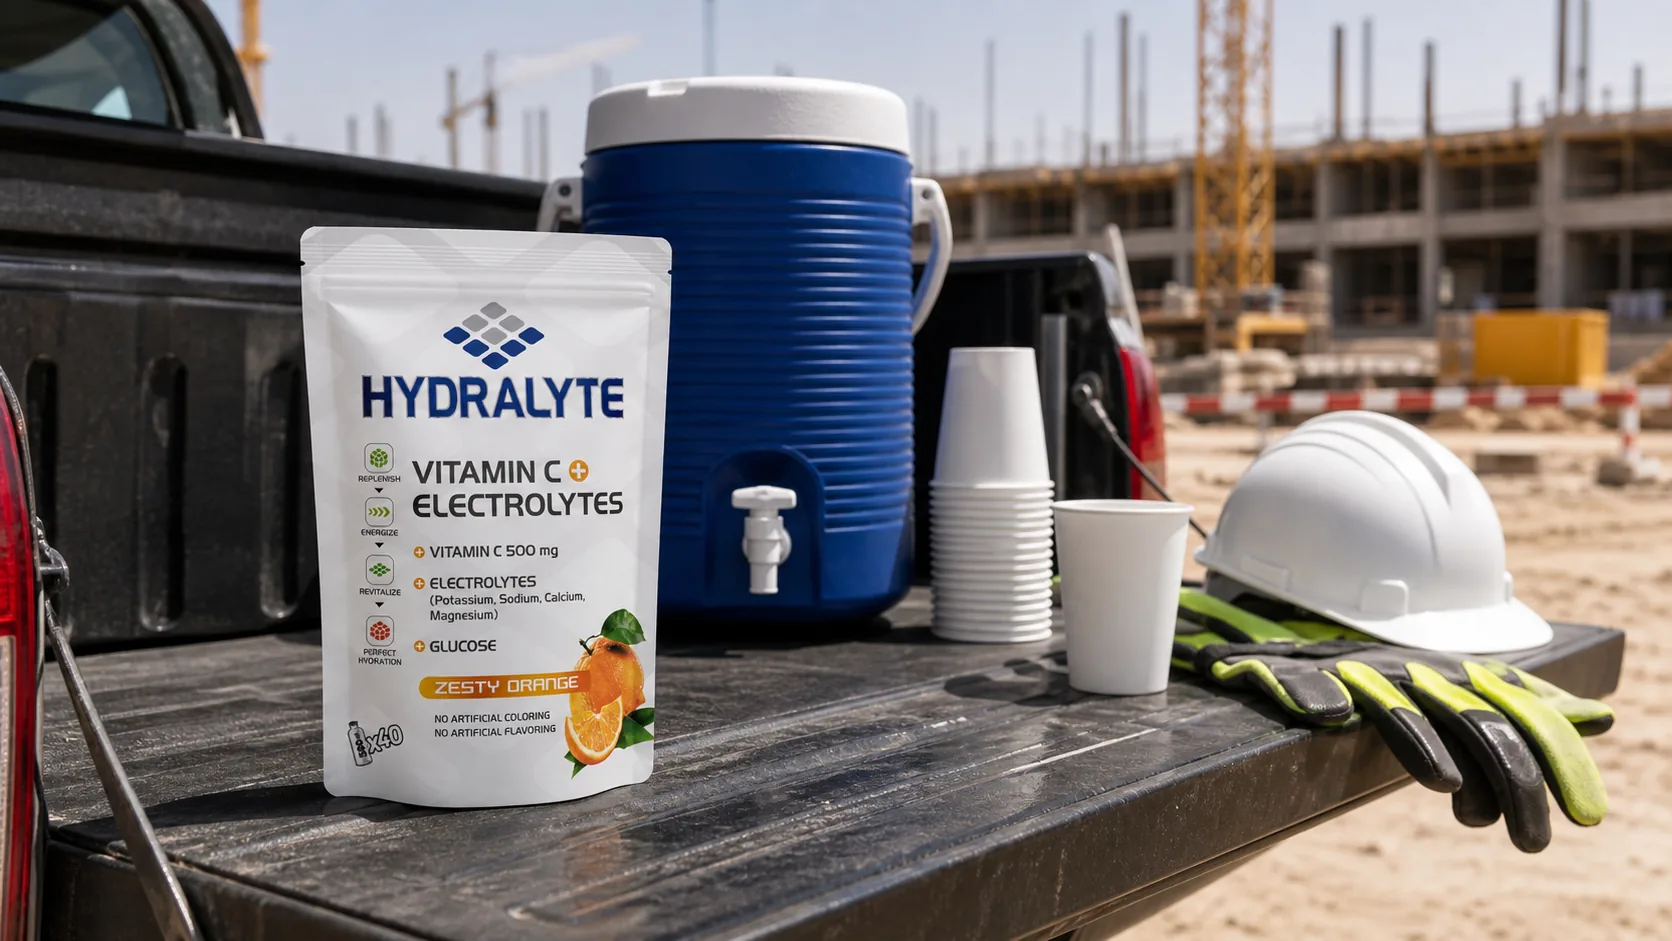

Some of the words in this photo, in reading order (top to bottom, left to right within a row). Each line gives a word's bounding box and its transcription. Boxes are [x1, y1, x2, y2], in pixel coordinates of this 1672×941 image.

[362, 375, 624, 418] HYDRALYTE
[412, 460, 535, 484] VITAMIN
[544, 460, 561, 483] C
[358, 475, 401, 483] REPLENISH
[412, 492, 623, 517] ELECTROLYTES
[361, 528, 399, 537] ENERGIZE
[430, 546, 489, 558] VITAMIN
[494, 545, 502, 557] C
[507, 545, 535, 557] 500
[540, 547, 559, 558] mg
[430, 576, 536, 589] ELECTROLYTES
[360, 588, 401, 596] REVITALIZE
[430, 595, 497, 606] (Potassium,
[499, 593, 542, 604] Sodium,
[545, 592, 586, 602] Calcium,
[430, 609, 499, 623] Magnesium)
[430, 640, 497, 653] GLUCOSE
[358, 657, 402, 666] HYDRATION
[434, 680, 500, 695] ZESTY
[507, 675, 579, 693] ORANGE
[434, 714, 449, 724] NO
[450, 713, 502, 724] ARTIFICIAL
[505, 711, 551, 722] COLORING
[434, 728, 449, 738] NO
[450, 727, 502, 738] ARTIFICIAL
[504, 724, 557, 736] FLAVORING
